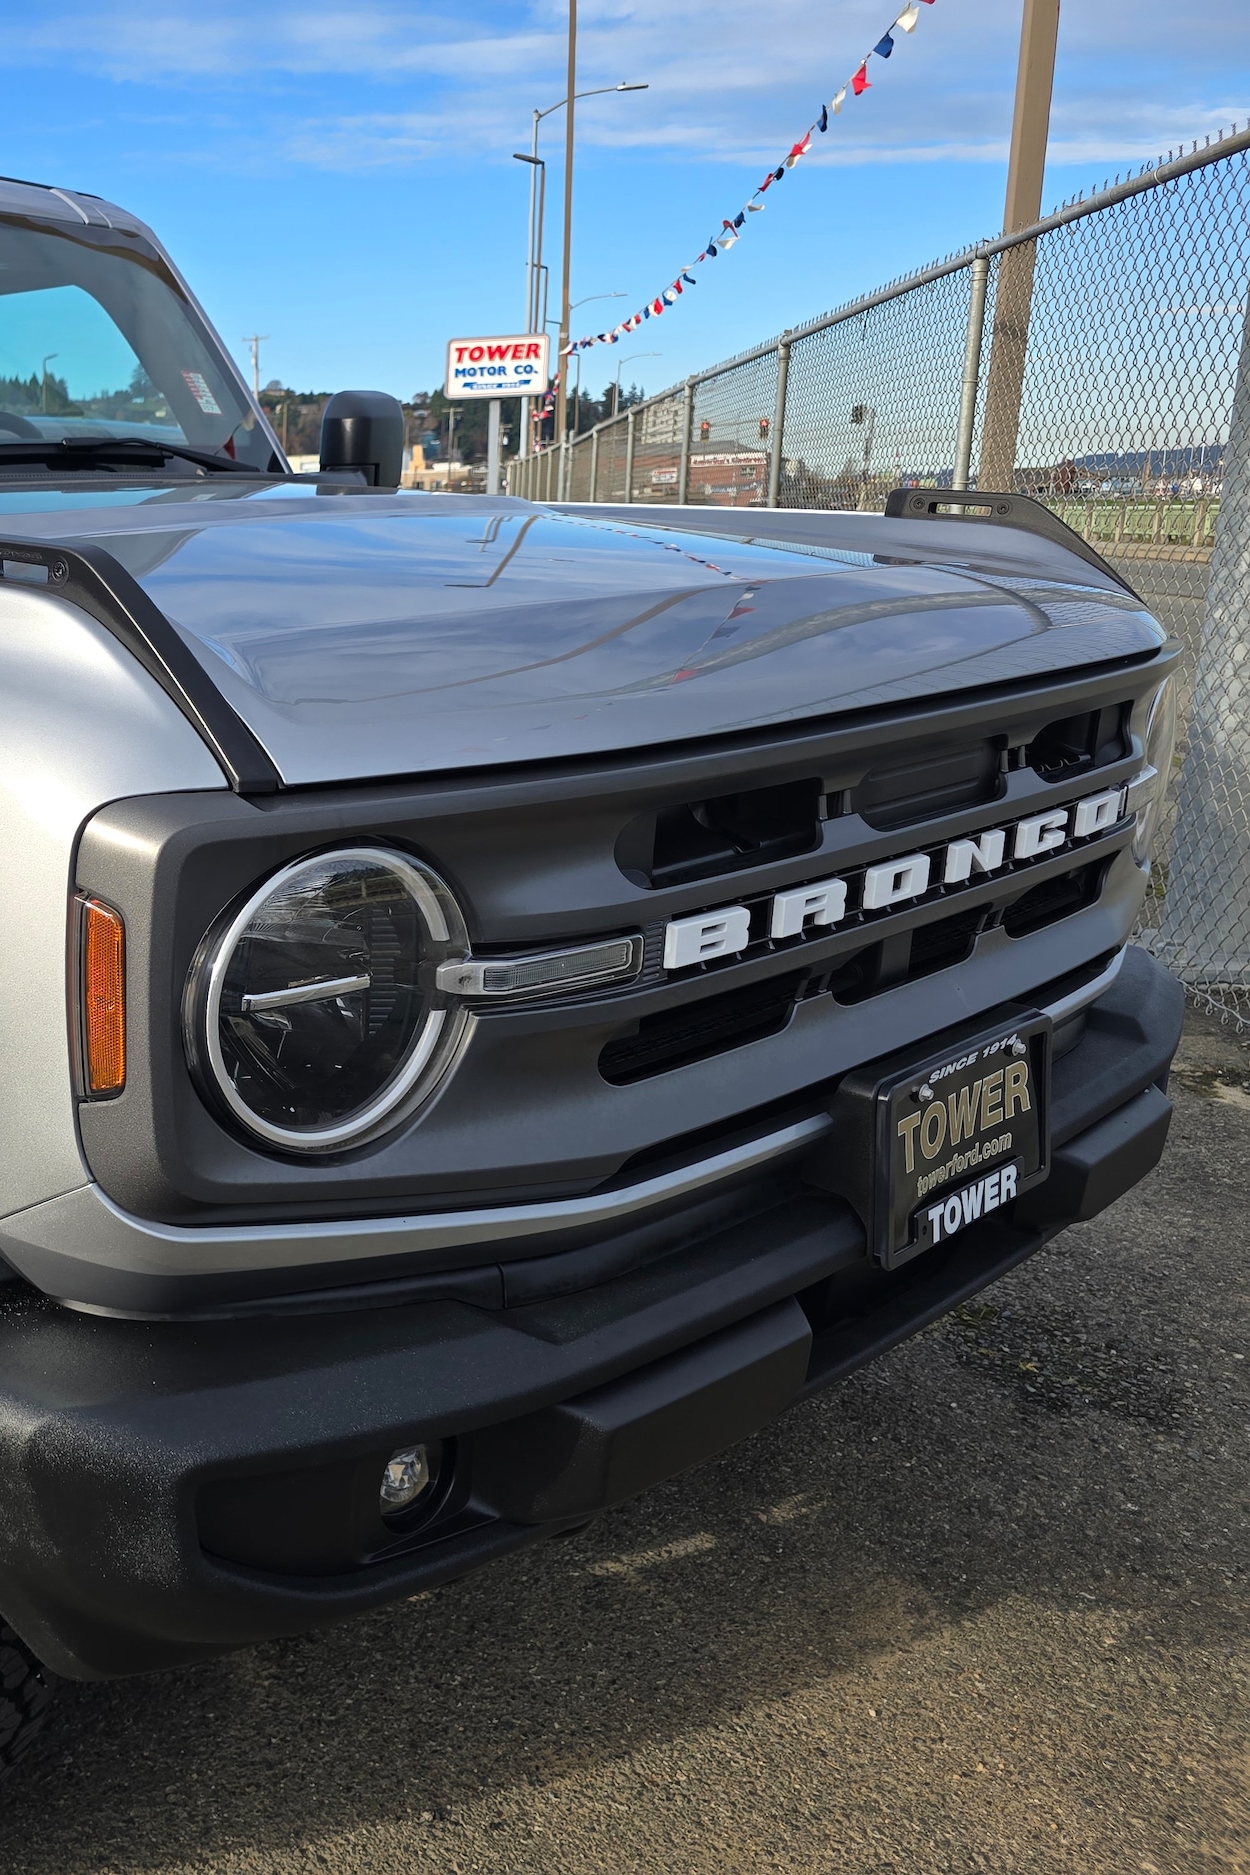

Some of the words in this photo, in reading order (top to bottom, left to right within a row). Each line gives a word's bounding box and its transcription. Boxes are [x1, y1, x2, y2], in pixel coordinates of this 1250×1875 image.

[454, 365, 507, 378] MOTOR
[514, 364, 539, 375] CO.
[455, 343, 541, 363] TOWER
[663, 788, 1123, 970] BRONCO
[928, 1049, 977, 1085] SINCE
[982, 1033, 1018, 1059] 1914
[897, 1060, 1032, 1174] TOWER
[916, 1131, 1013, 1198] towerford.com
[928, 1164, 1018, 1244] TOWER
